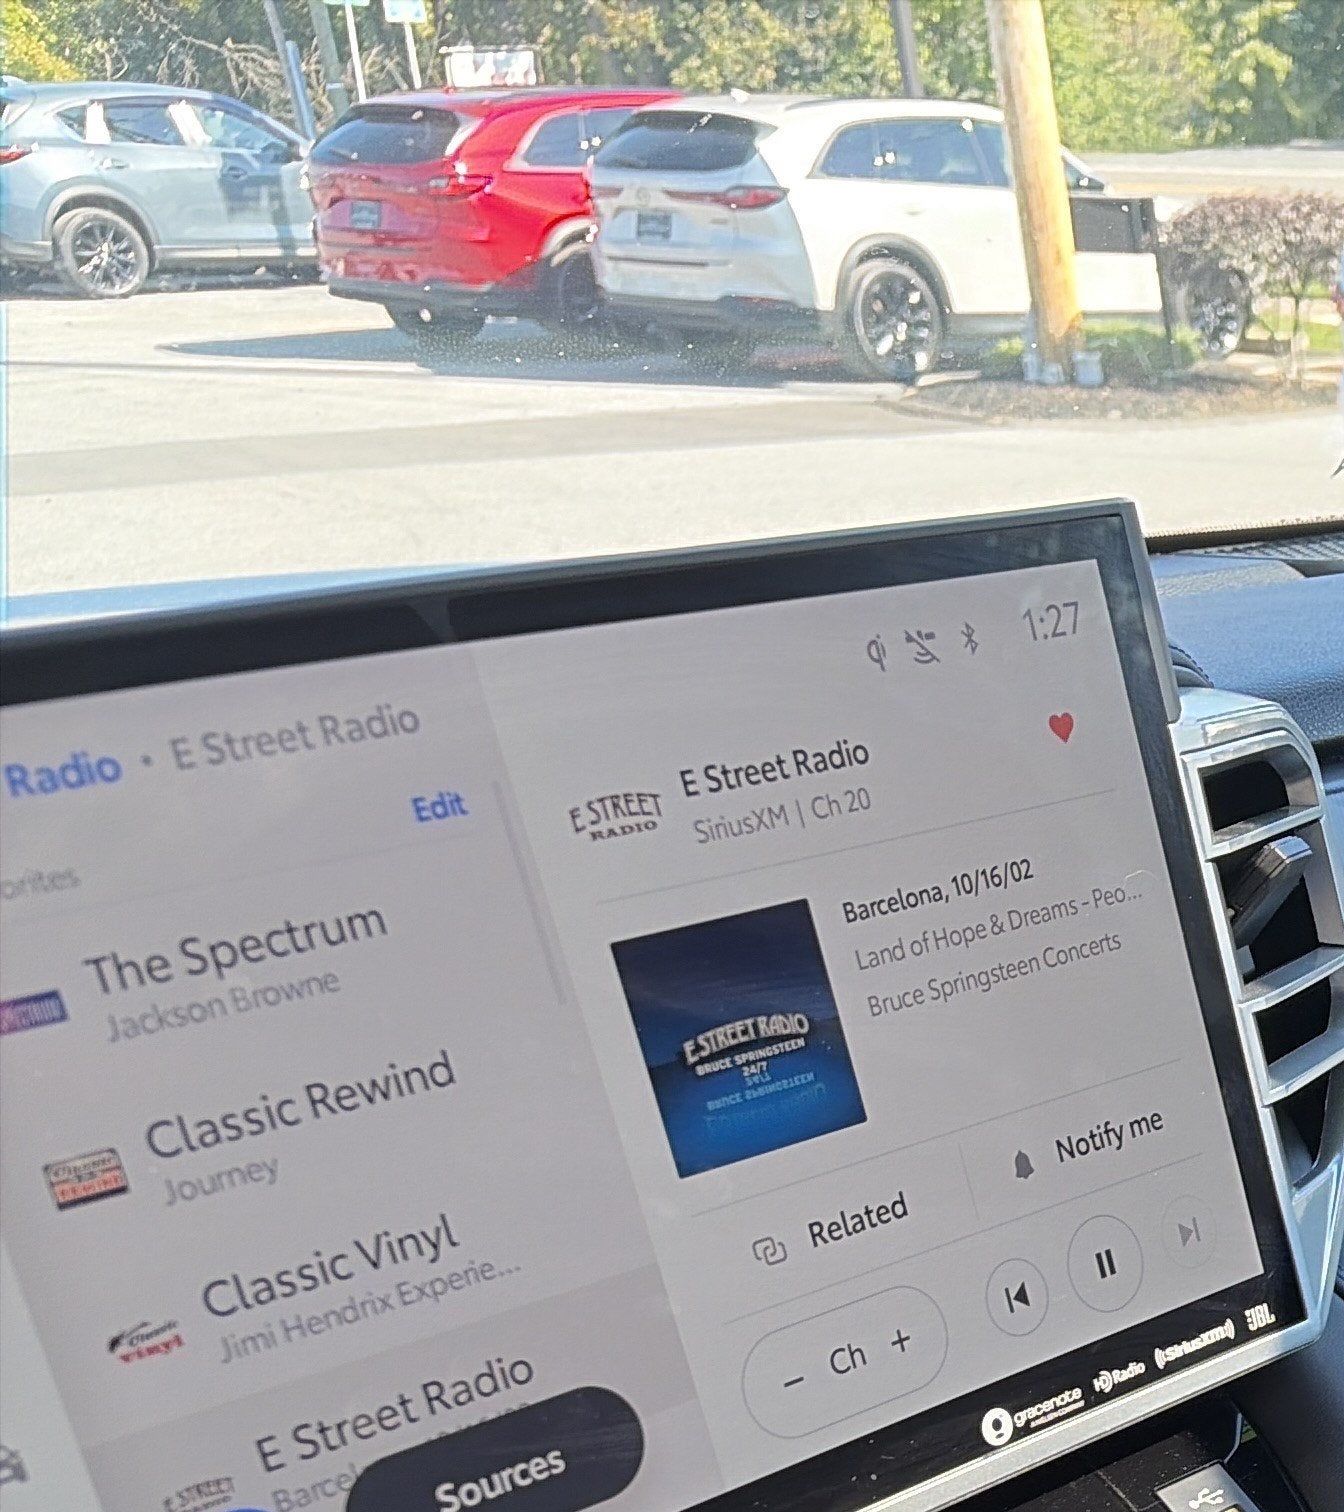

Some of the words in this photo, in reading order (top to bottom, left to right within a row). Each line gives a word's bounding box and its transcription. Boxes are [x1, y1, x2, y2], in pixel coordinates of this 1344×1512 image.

[1023, 601, 1081, 642] 1:27
[4, 752, 122, 798] Radio
[171, 739, 197, 771] E
[202, 718, 317, 768] Street
[318, 704, 421, 747] Radio
[680, 770, 699, 797] E
[704, 753, 791, 794] Street
[793, 739, 870, 775] Radio
[411, 792, 468, 822] Edit
[570, 807, 585, 833] E
[586, 792, 663, 825] STREET
[589, 820, 658, 841] RADIO
[694, 804, 789, 845] SiriusXM
[811, 792, 842, 822] Ch
[846, 787, 872, 815] 20
[0, 866, 81, 899] orites
[843, 881, 949, 924] Barcelona,
[951, 857, 1034, 899] 10/16/02
[82, 951, 174, 995] The
[179, 906, 388, 977] Spectrum
[856, 940, 904, 972] Land
[910, 932, 931, 958] of
[933, 918, 988, 955] Hope
[990, 912, 1005, 936] &
[1008, 898, 1078, 931] Dreams
[868, 986, 925, 1018] Bruce
[927, 955, 1041, 1004] Springsteen
[1043, 932, 1122, 970] Concerts
[105, 996, 225, 1043] Jackson
[230, 971, 341, 1013] Browne
[698, 1017, 757, 1056] STREET
[758, 1013, 809, 1038] RADIO
[695, 1057, 734, 1076] BRUCE
[734, 1038, 806, 1066] SPRINGSTEEN
[145, 1095, 302, 1160] Classic
[305, 1049, 456, 1119] Rewind
[1055, 1117, 1125, 1165] Notify
[1129, 1110, 1164, 1140] me
[163, 1157, 280, 1205] Journey
[808, 1191, 909, 1249] Related
[201, 1250, 353, 1319] Classic
[355, 1213, 458, 1272] Vinyl
[220, 1326, 275, 1364] Jimi
[280, 1294, 394, 1344] Hendrix
[1245, 1303, 1276, 1331] JBL
[829, 1343, 867, 1376] Ch
[1112, 1361, 1146, 1384] Radio
[256, 1435, 286, 1472] E
[292, 1394, 420, 1460] Street
[421, 1357, 533, 1416] Radio
[1014, 1387, 1082, 1427] gracenote
